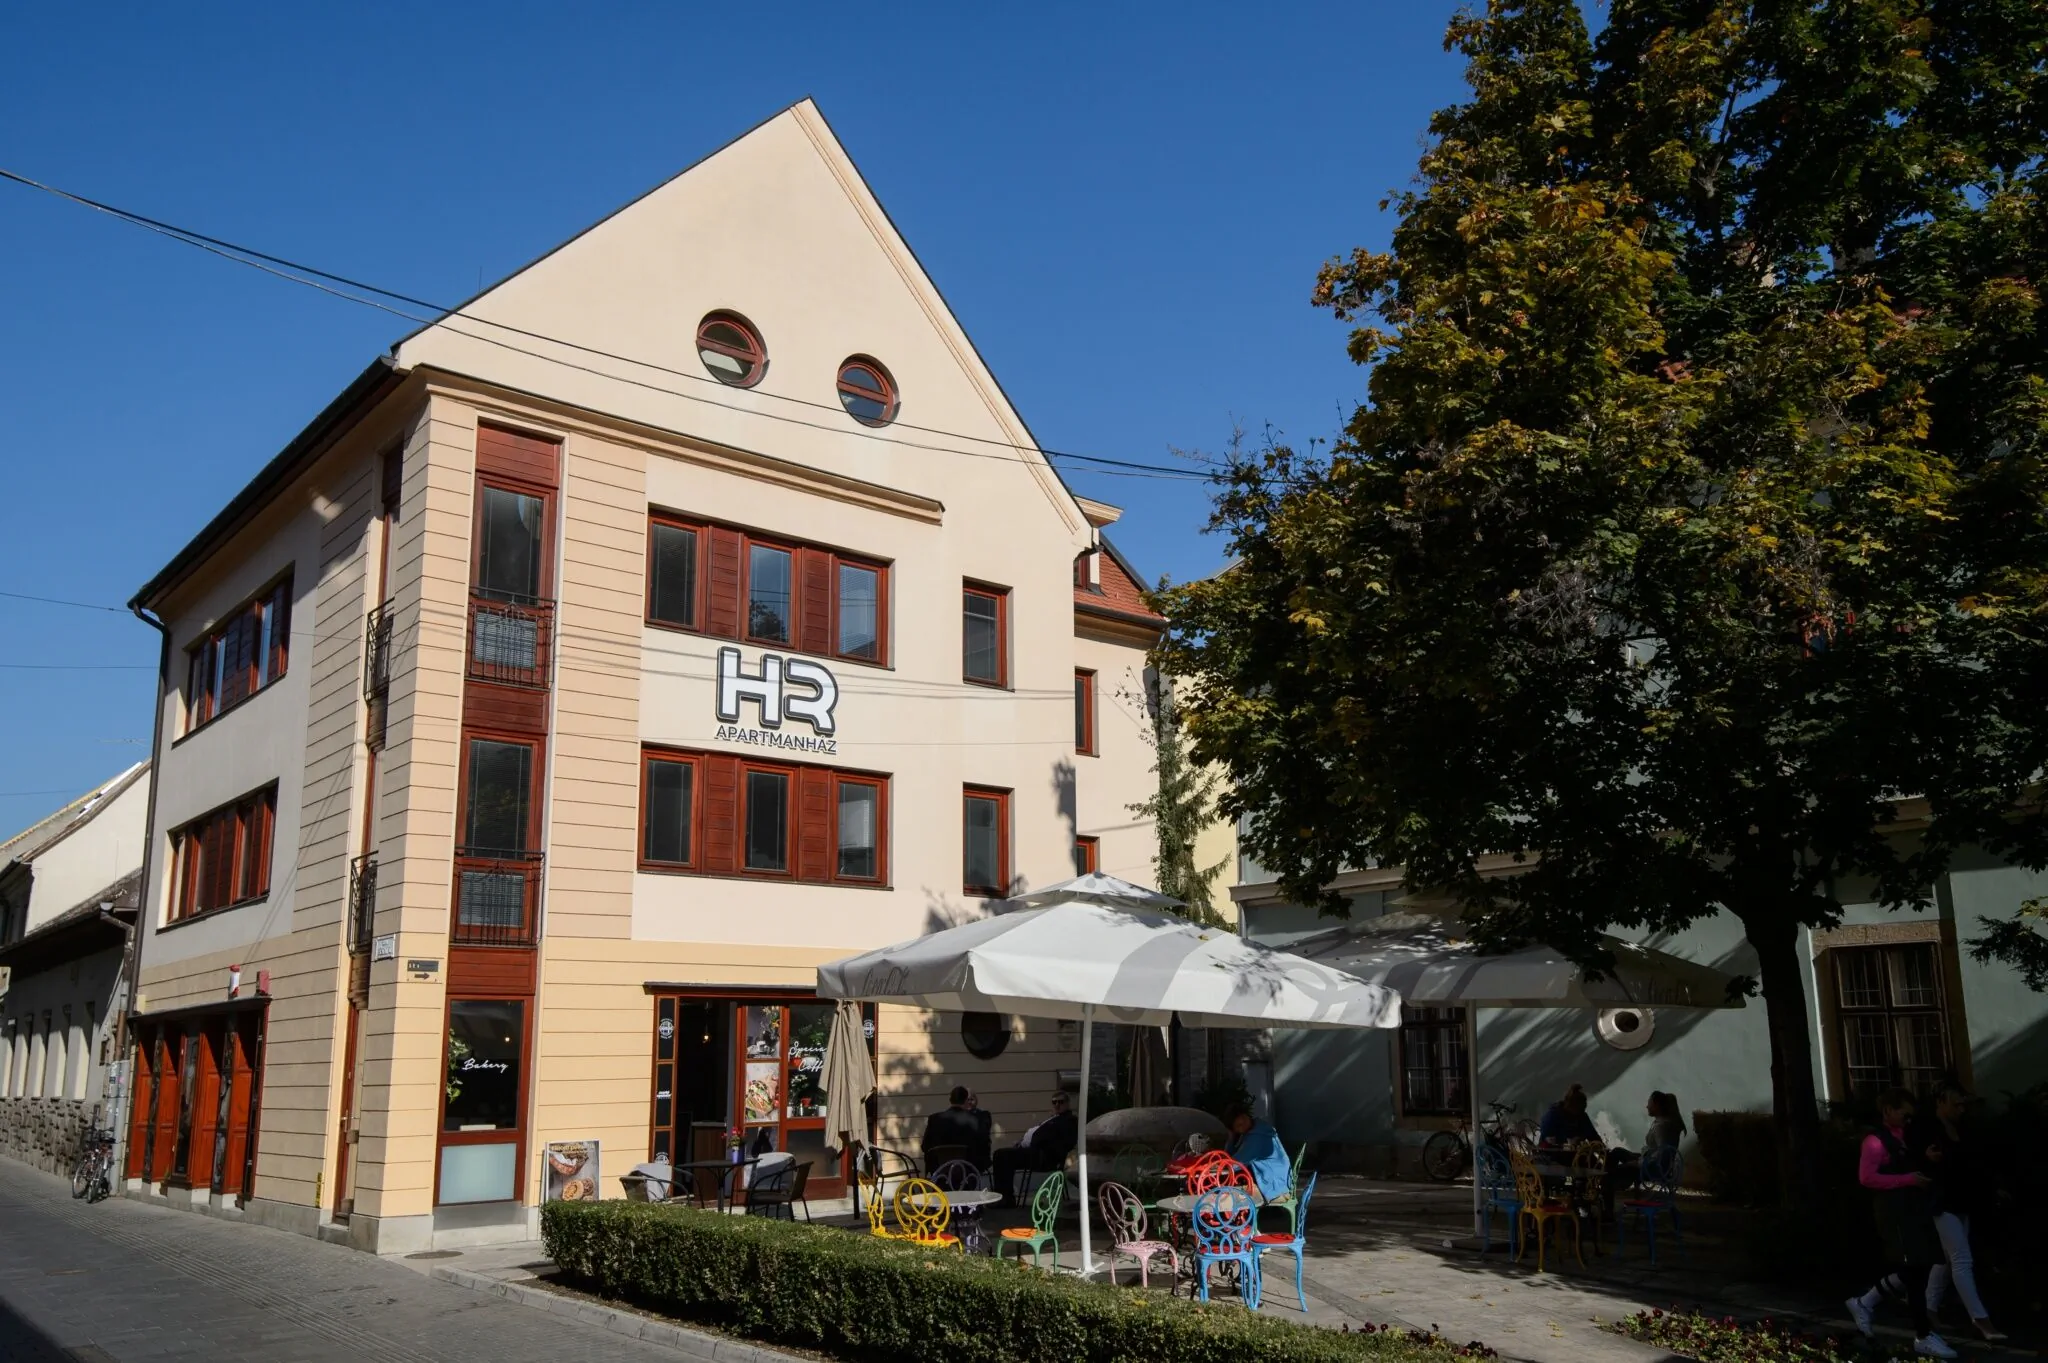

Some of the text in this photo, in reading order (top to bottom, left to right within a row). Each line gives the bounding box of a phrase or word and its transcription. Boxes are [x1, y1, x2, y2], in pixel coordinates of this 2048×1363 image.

[715, 646, 839, 737] HR
[714, 725, 837, 753] APARTMANHÁZ
[463, 1058, 509, 1073] Bakery
